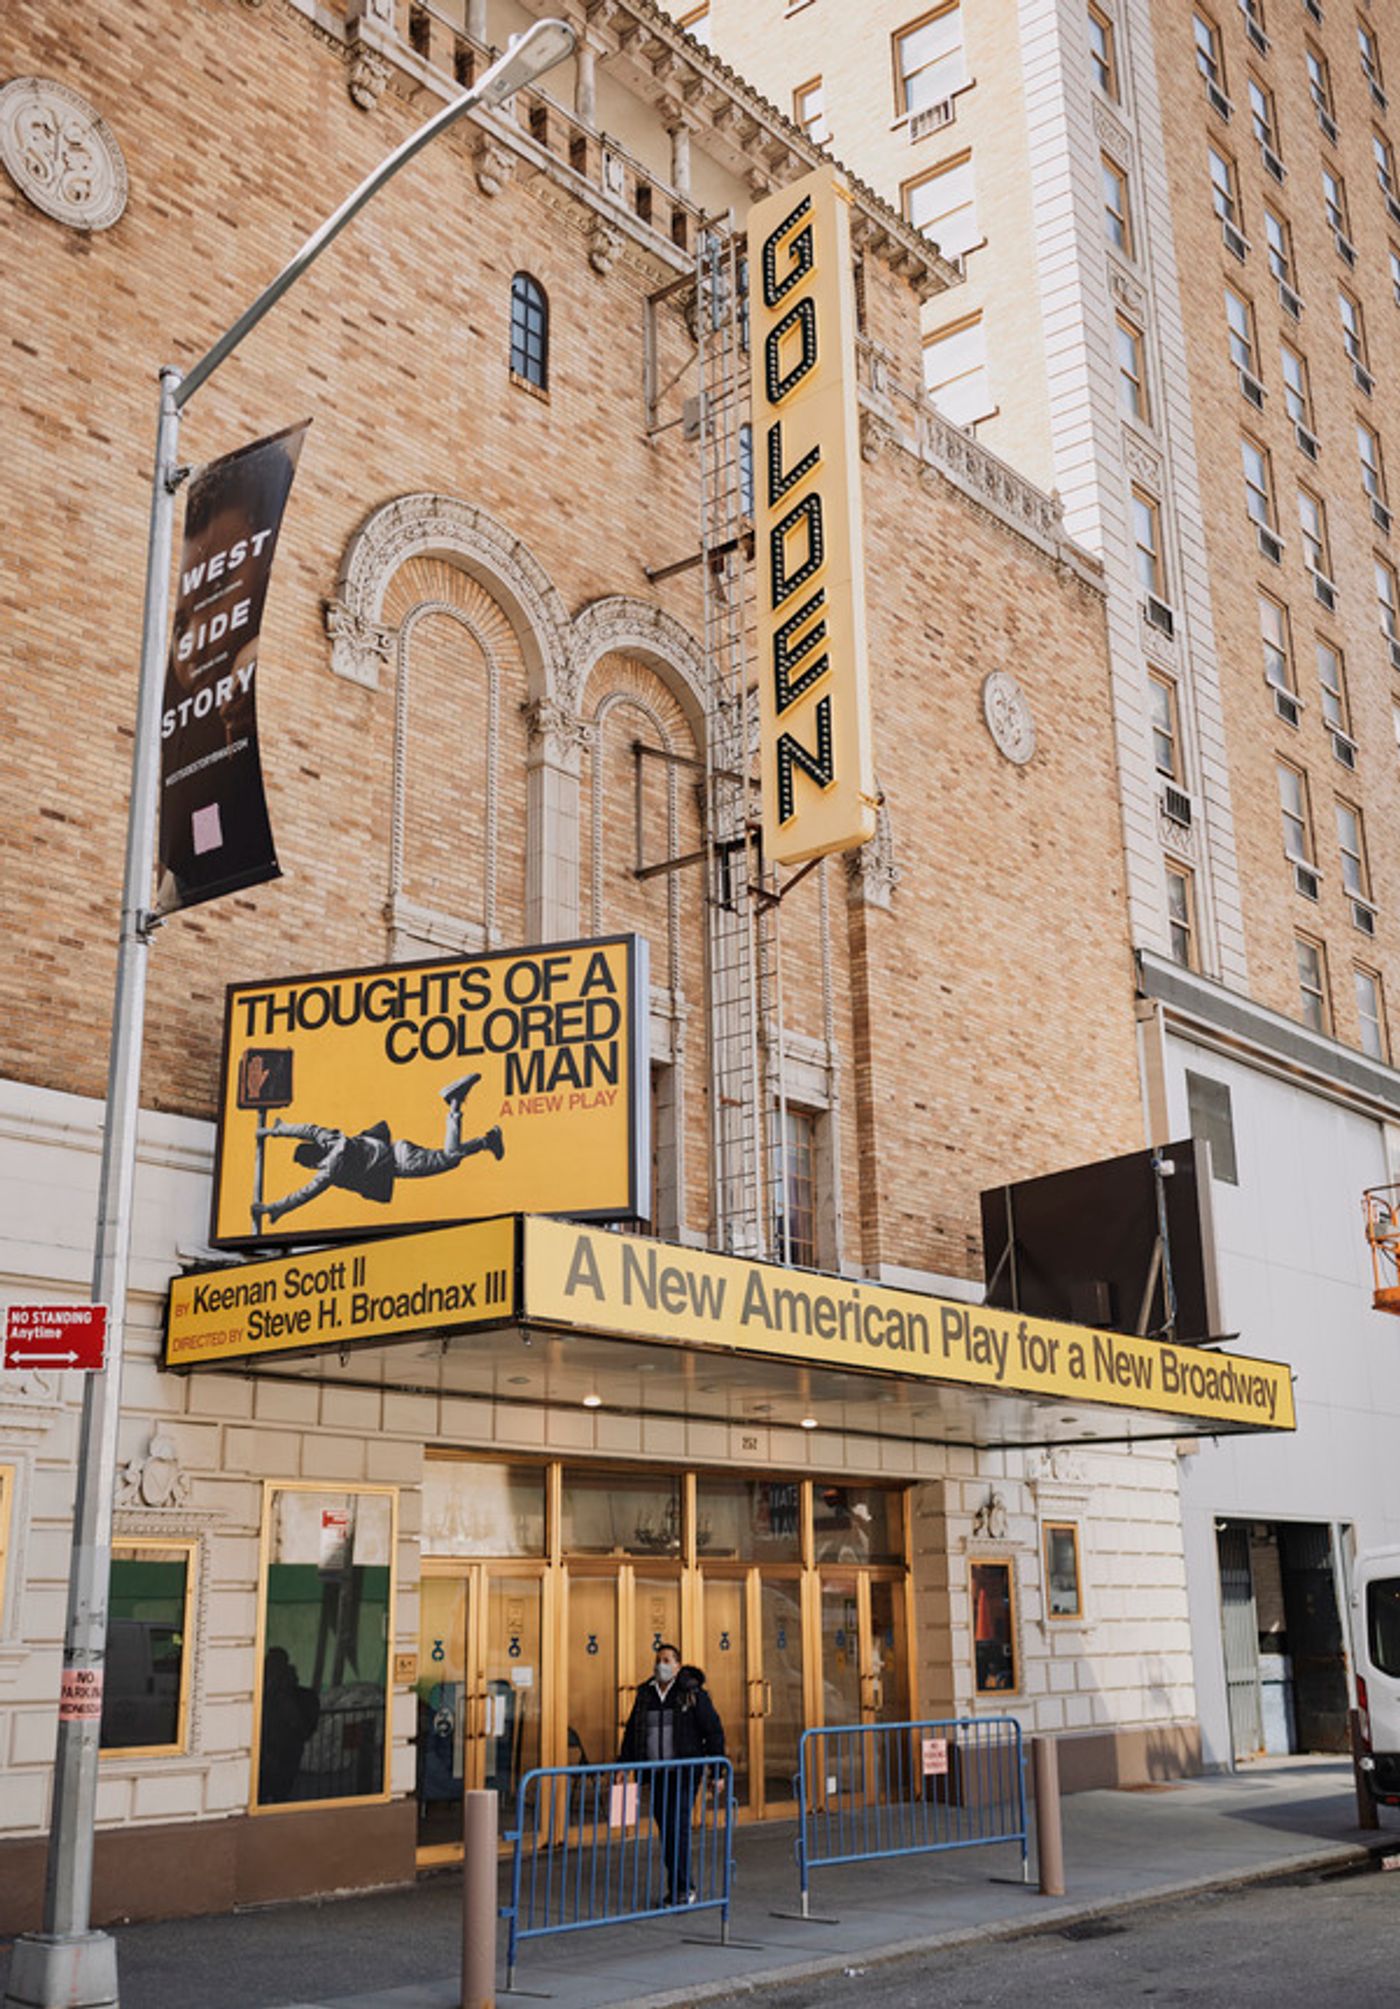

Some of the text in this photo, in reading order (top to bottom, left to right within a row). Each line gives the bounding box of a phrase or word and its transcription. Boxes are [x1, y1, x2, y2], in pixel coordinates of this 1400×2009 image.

[762, 194, 834, 826] GOLDEN
[181, 529, 272, 596] WEST
[177, 598, 251, 662] SIDE
[161, 661, 256, 738] STORY
[237, 951, 617, 1037] THOUGHTS OF A
[384, 996, 621, 1065] COLORED
[504, 1041, 619, 1097] MAN
[499, 1089, 619, 1119] A NEW PLAY
[11, 1311, 92, 1324] NO STANDING
[172, 1269, 508, 1353] DIRECTED BY Steve H. Broadnax III
[175, 1255, 366, 1318] BY Keenan Scott II
[11, 1327, 63, 1342] Anytime
[564, 1235, 1278, 1420] A New American Play for a New Broadway
[76, 1671, 95, 1684] NO
